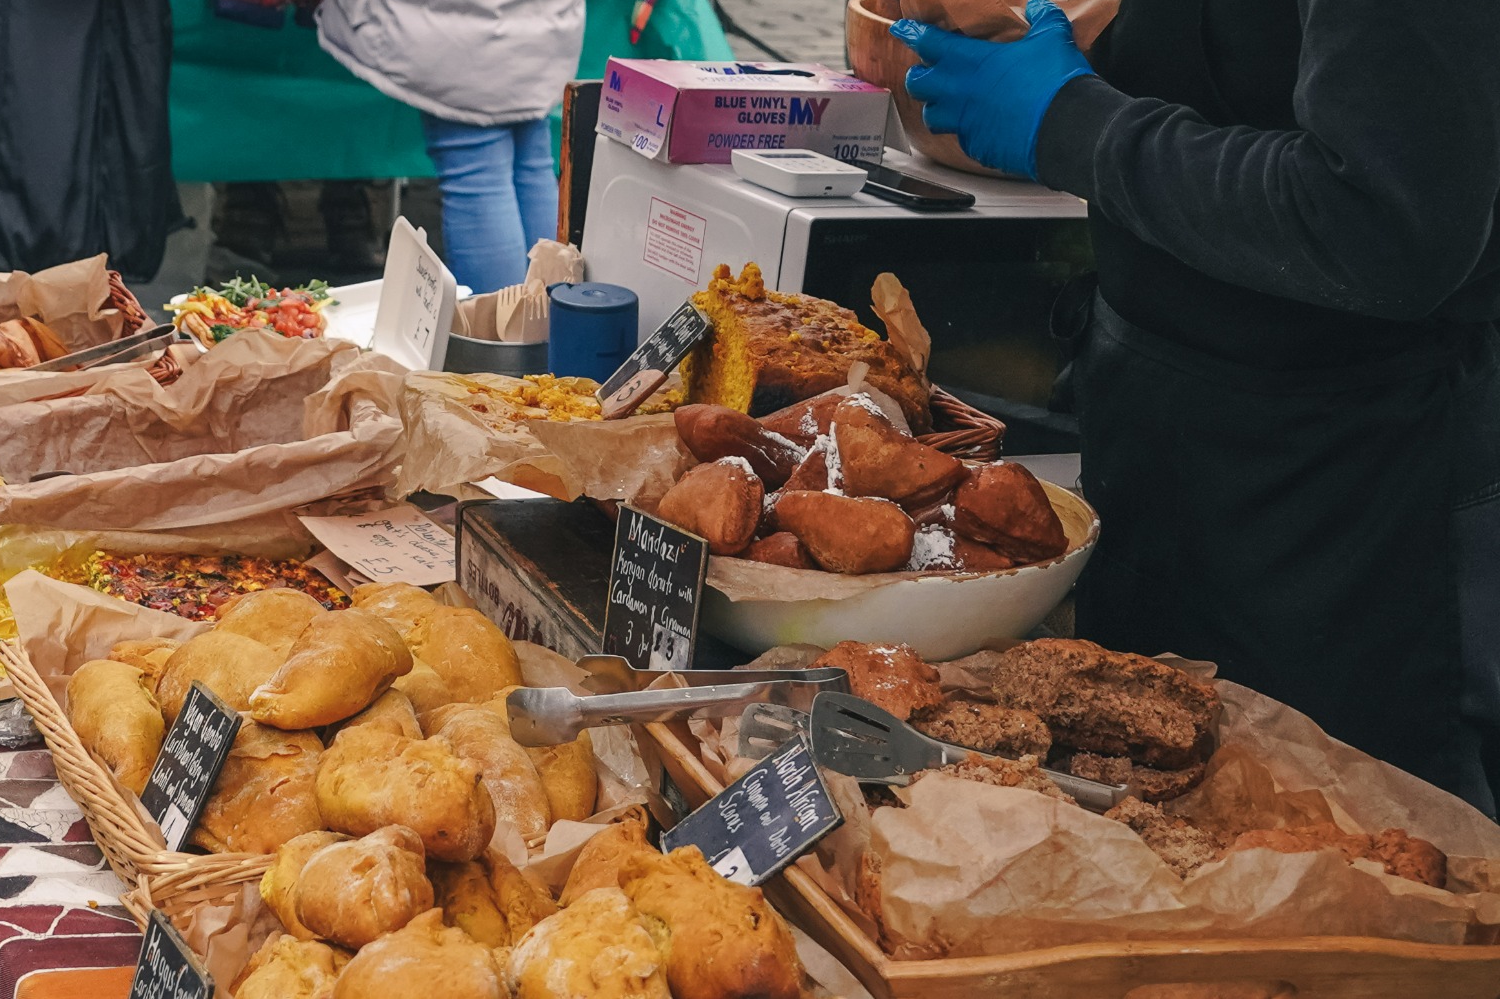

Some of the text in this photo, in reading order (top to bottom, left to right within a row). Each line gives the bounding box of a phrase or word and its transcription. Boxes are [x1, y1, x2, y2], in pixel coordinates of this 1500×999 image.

[656, 104, 665, 128] L
[714, 96, 831, 126] BLUE VINYL MY
[737, 111, 787, 125] GLOVES
[707, 133, 787, 150] POWDER FREE
[833, 143, 860, 160] 100
[628, 512, 680, 563] Mandazi
[467, 558, 500, 607] BOTTLES
[616, 547, 646, 586] Kenyan
[678, 585, 693, 604] with
[625, 620, 634, 646] 3
[183, 688, 205, 737] Vegan
[771, 743, 820, 832] North African
[718, 790, 745, 834] Scones
[758, 811, 781, 827] and
